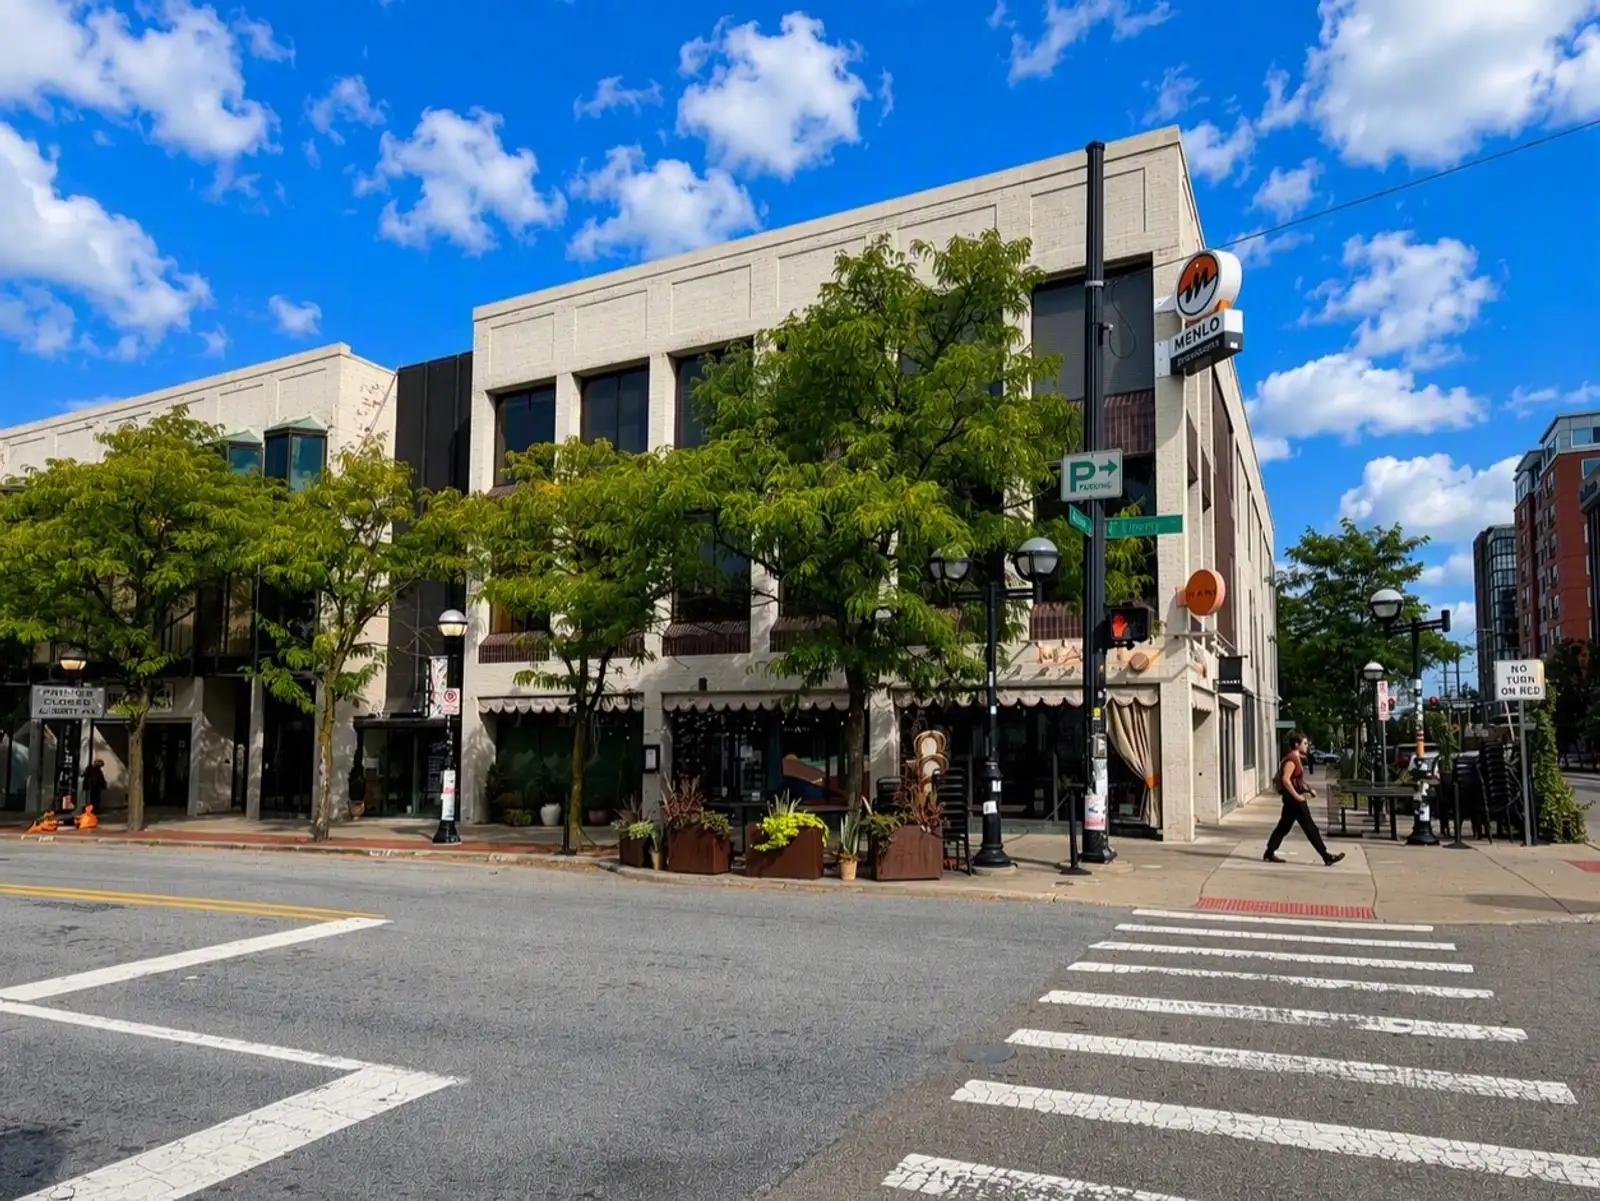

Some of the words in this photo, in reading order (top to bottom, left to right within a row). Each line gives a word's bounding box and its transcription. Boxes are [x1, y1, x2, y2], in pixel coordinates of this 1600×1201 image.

[1174, 316, 1220, 353] MENLO
[1070, 461, 1096, 493] P
[1511, 664, 1527, 674] NO
[1506, 675, 1535, 685] TURN
[1501, 687, 1516, 696] ON
[1520, 686, 1541, 696] RED
[43, 698, 91, 706] CLOSED
